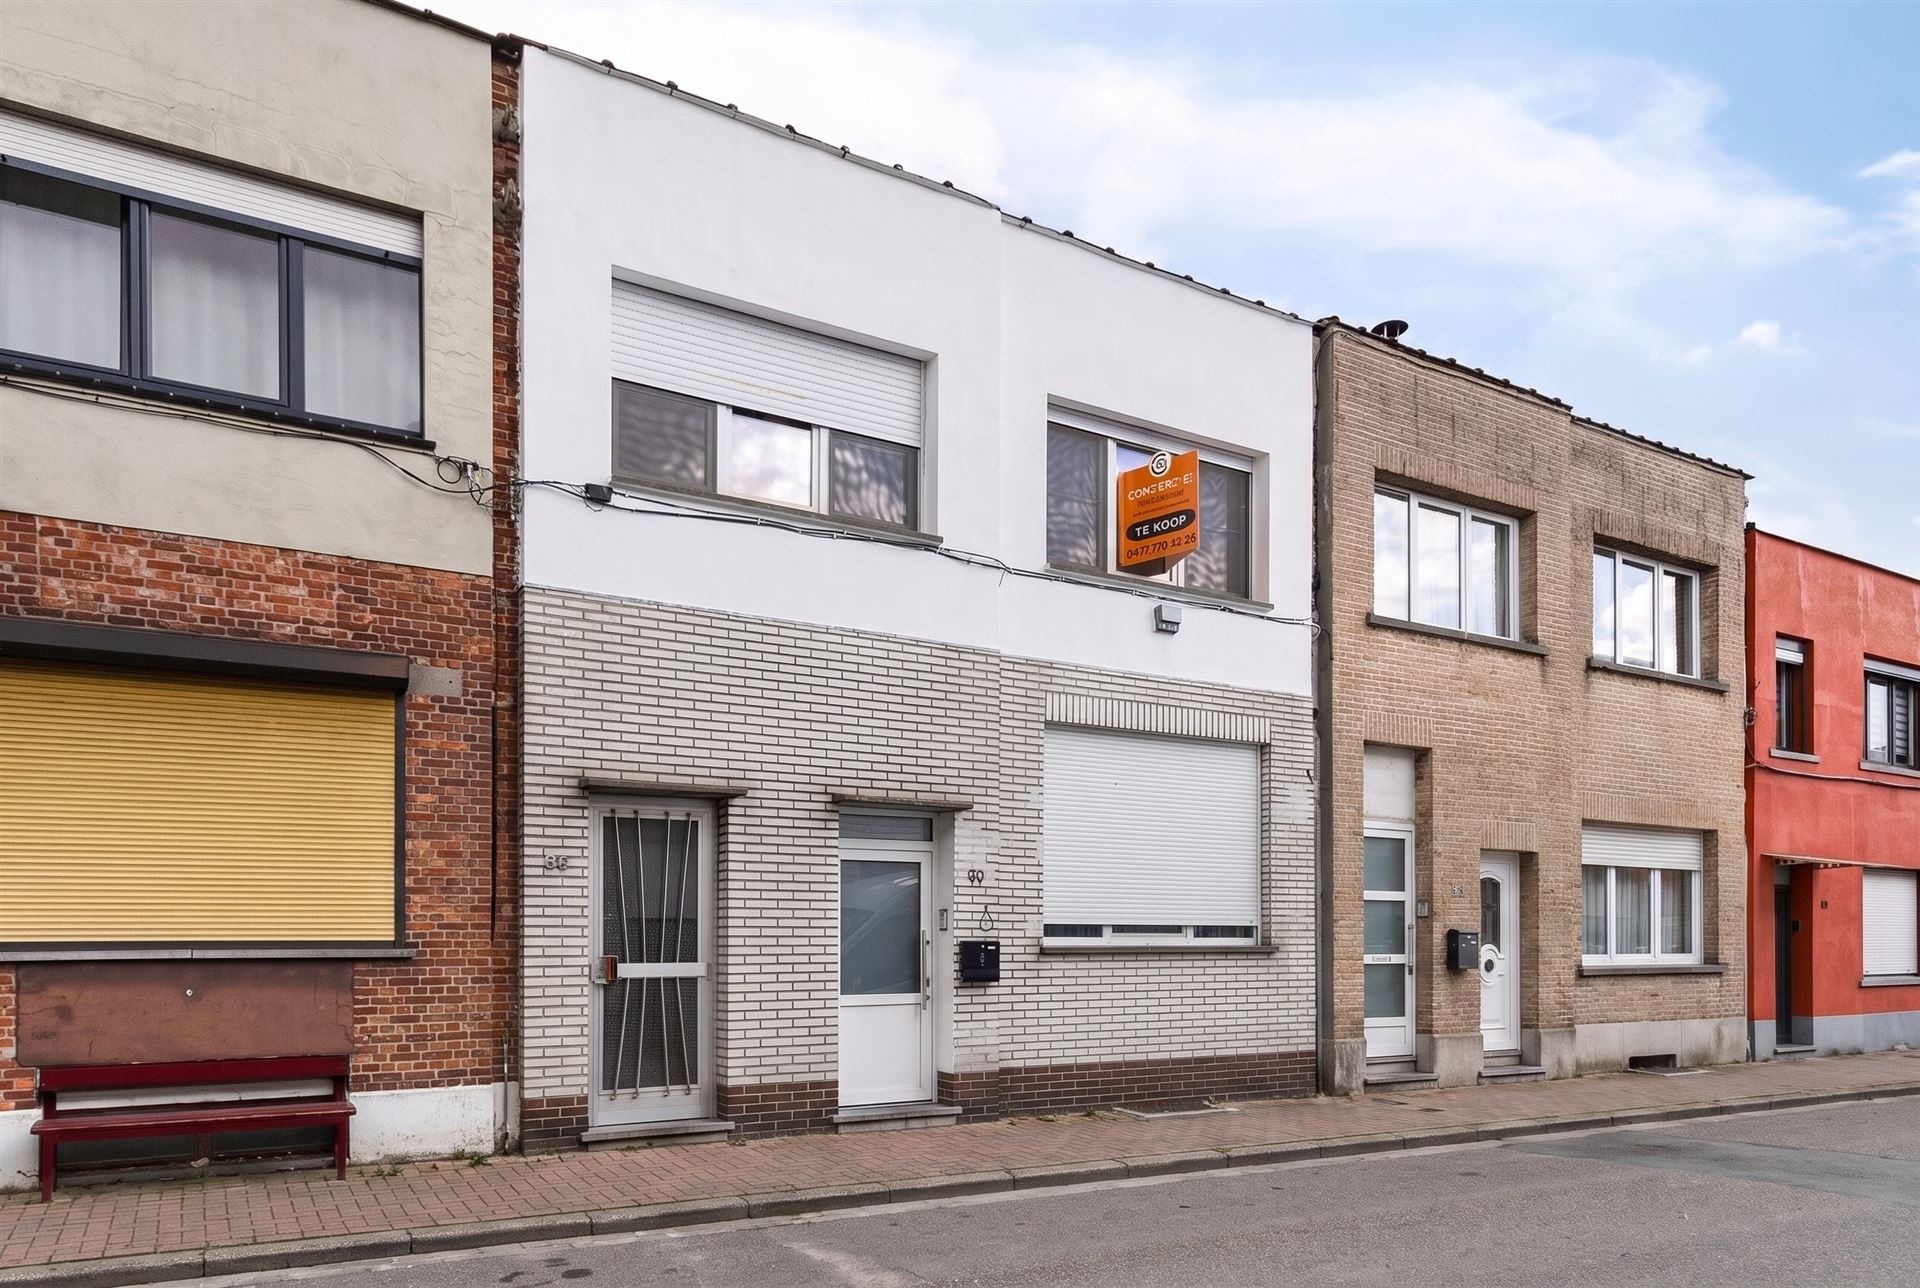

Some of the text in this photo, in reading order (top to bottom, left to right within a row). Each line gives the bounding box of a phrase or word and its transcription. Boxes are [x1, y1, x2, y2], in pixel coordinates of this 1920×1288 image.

[1135, 514, 1187, 537] TE KOOP
[1184, 533, 1197, 545] 26
